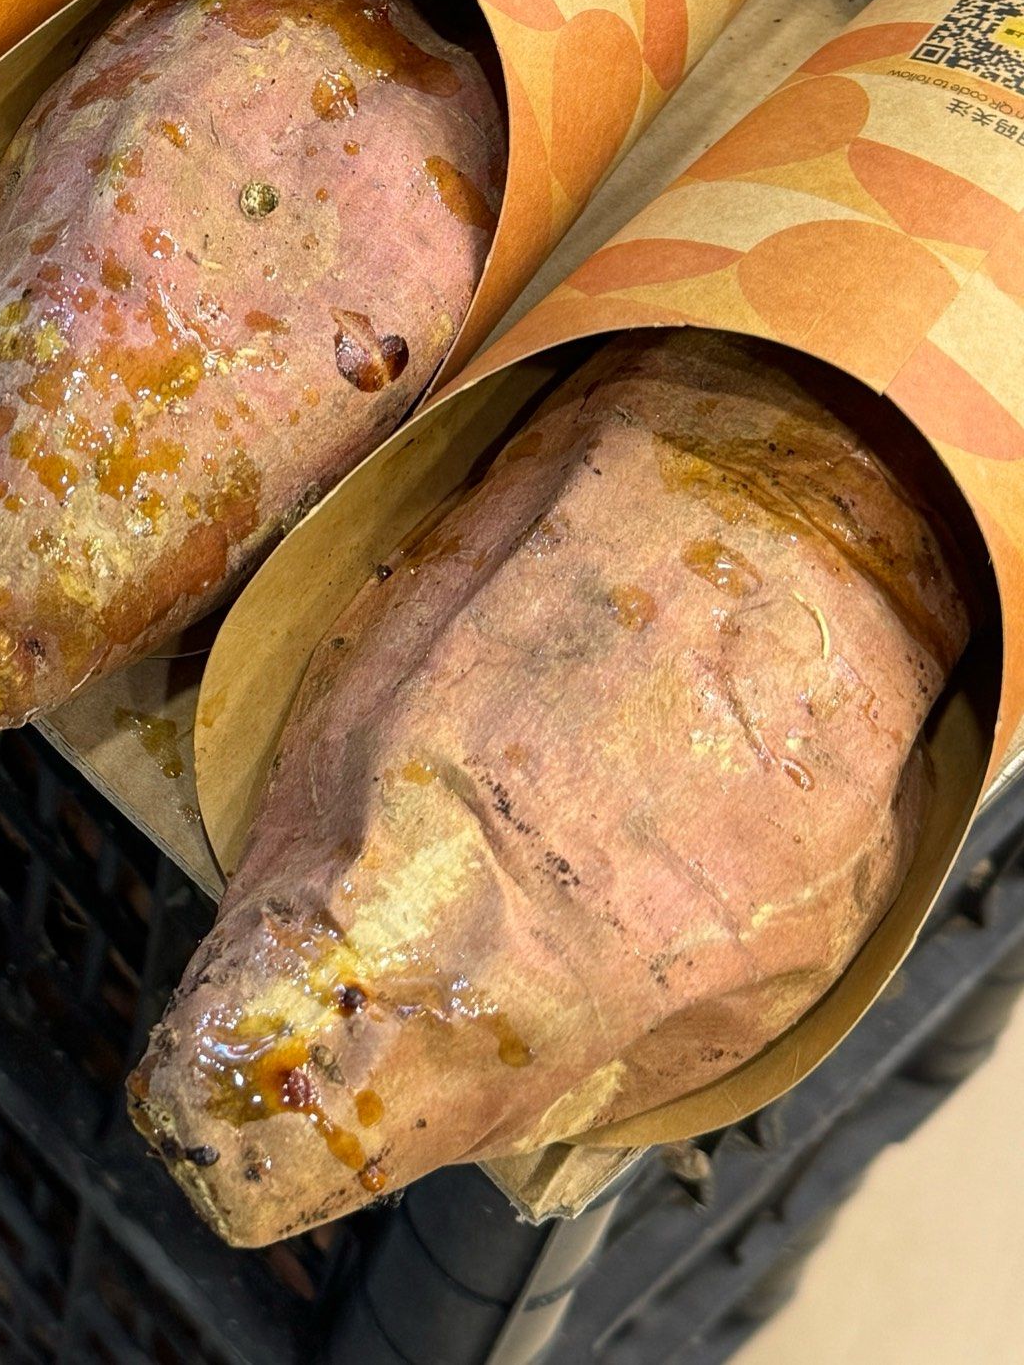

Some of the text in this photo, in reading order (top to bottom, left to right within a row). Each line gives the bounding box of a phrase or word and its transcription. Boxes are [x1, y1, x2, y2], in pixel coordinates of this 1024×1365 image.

[887, 68, 932, 86] follow
[933, 78, 950, 90] to
[950, 84, 989, 103] code
[989, 99, 1014, 117] QR
